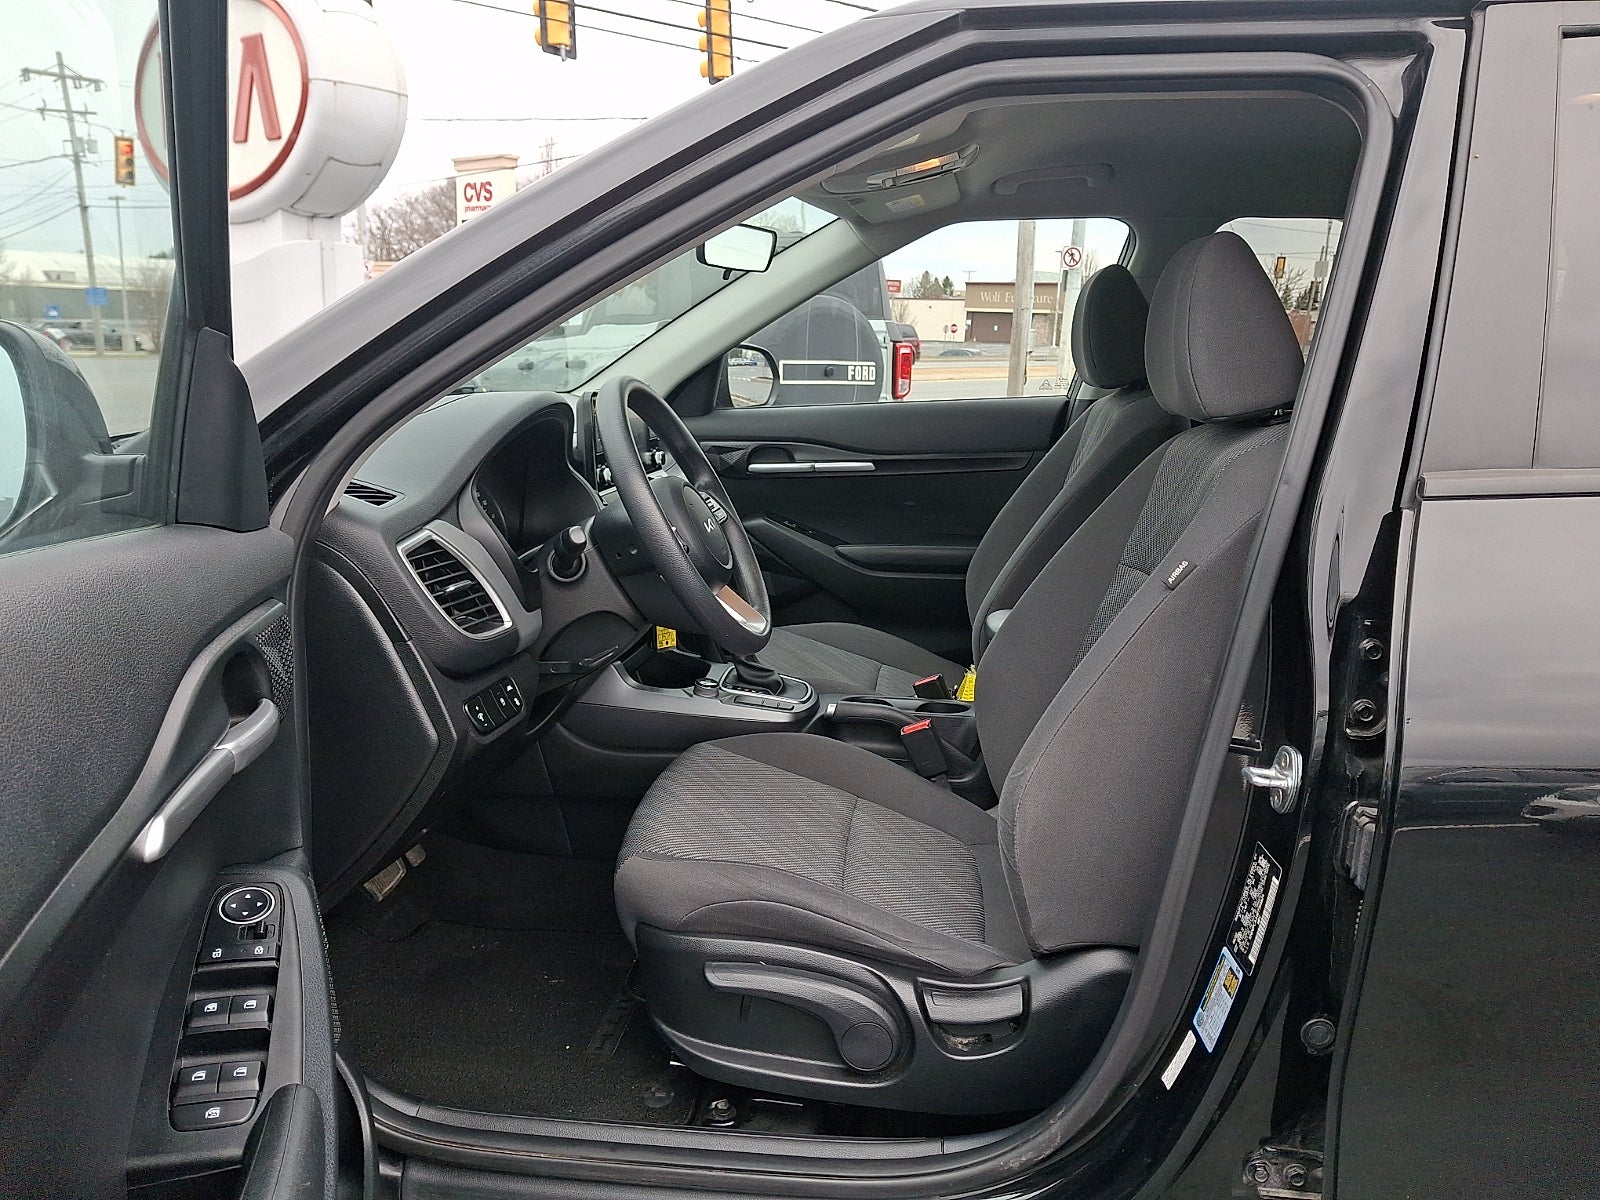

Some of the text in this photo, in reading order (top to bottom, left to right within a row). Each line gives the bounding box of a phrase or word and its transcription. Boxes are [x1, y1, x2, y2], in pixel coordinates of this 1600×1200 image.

[464, 181, 493, 203] CVS
[464, 205, 492, 213] pharma
[980, 291, 1001, 303] Wolf
[847, 365, 876, 381] FORD
[1167, 560, 1189, 585] AIRBAG
